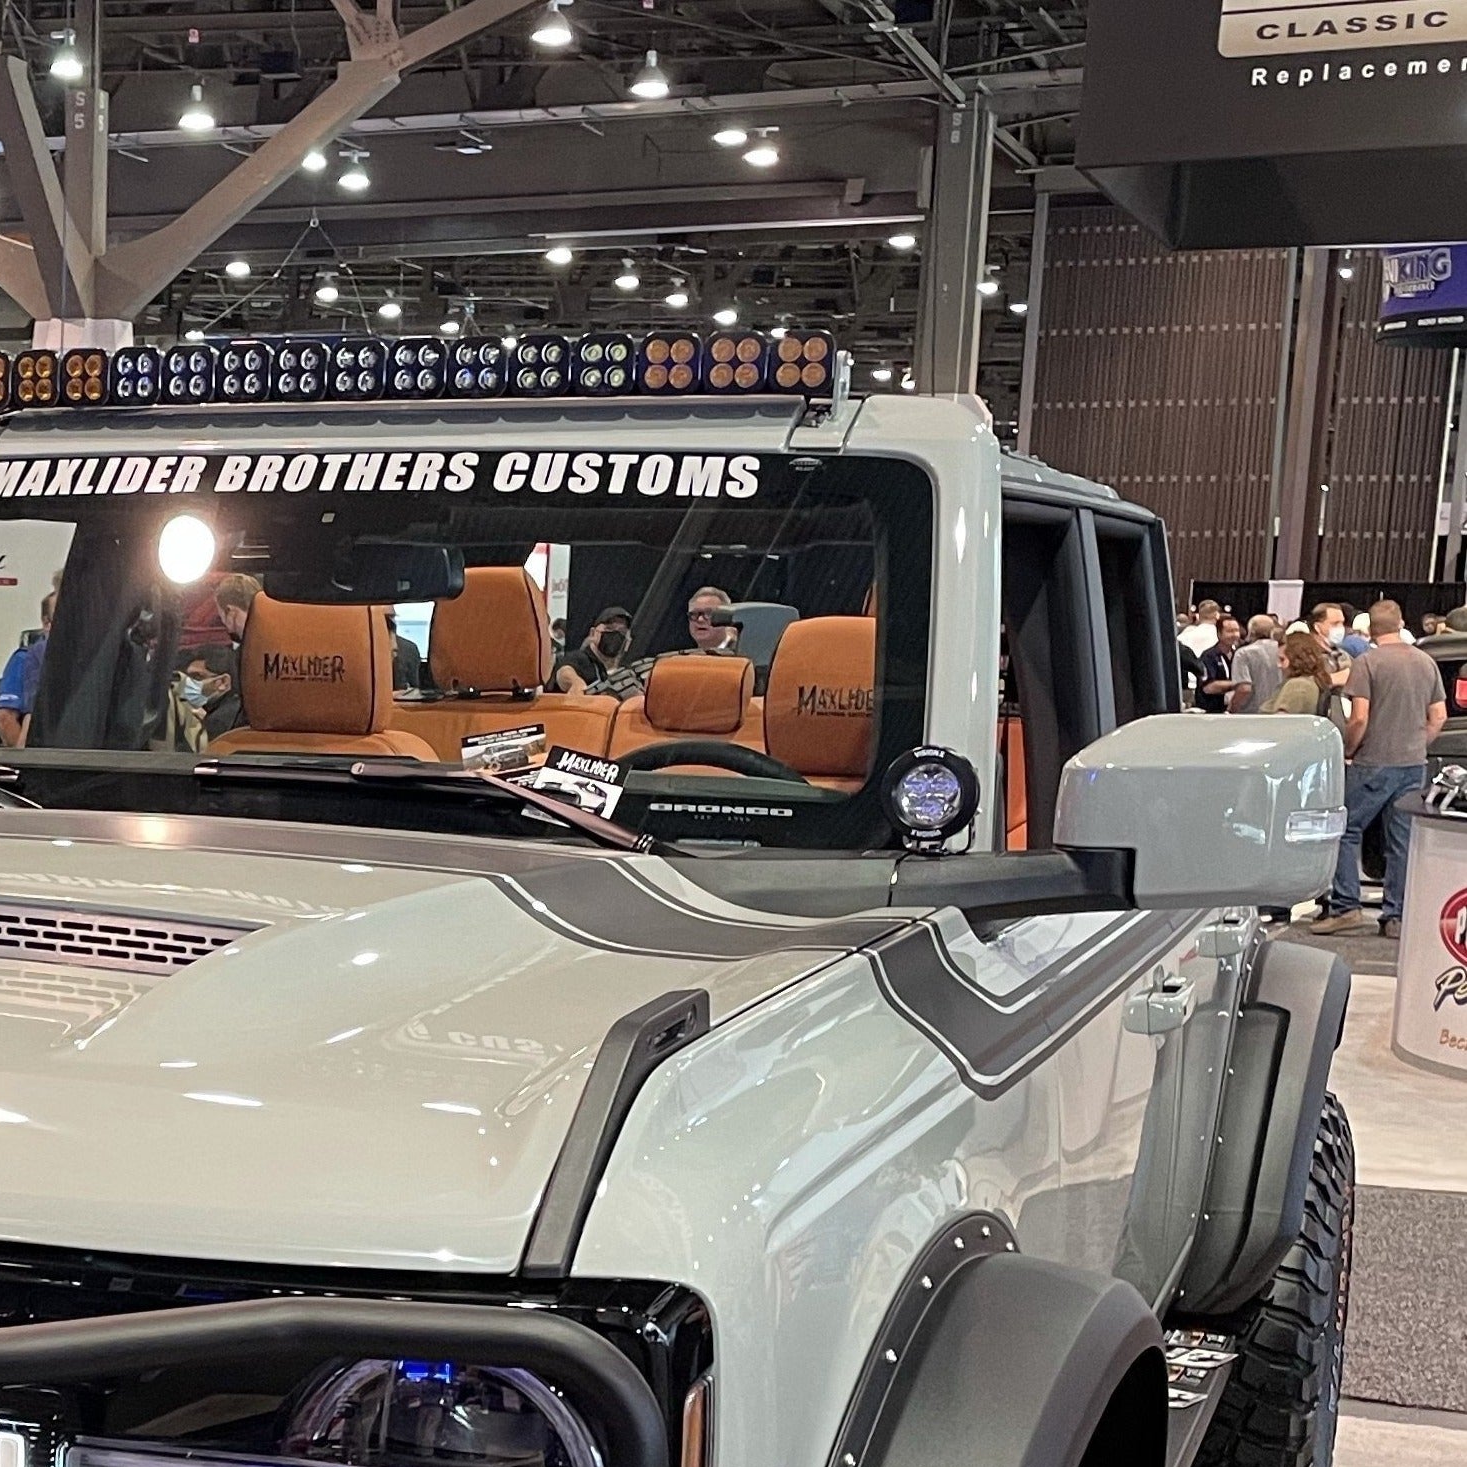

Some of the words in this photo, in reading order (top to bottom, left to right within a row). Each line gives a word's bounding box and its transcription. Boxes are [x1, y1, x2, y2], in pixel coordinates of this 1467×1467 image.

[1255, 11, 1450, 40] CLASSIC
[216, 452, 479, 495] BROTHERS
[493, 452, 761, 499] CUSTOMS
[263, 652, 346, 683] MAXLIDER
[796, 685, 873, 716] MAXLIDE
[556, 751, 621, 784] MAXLIDER
